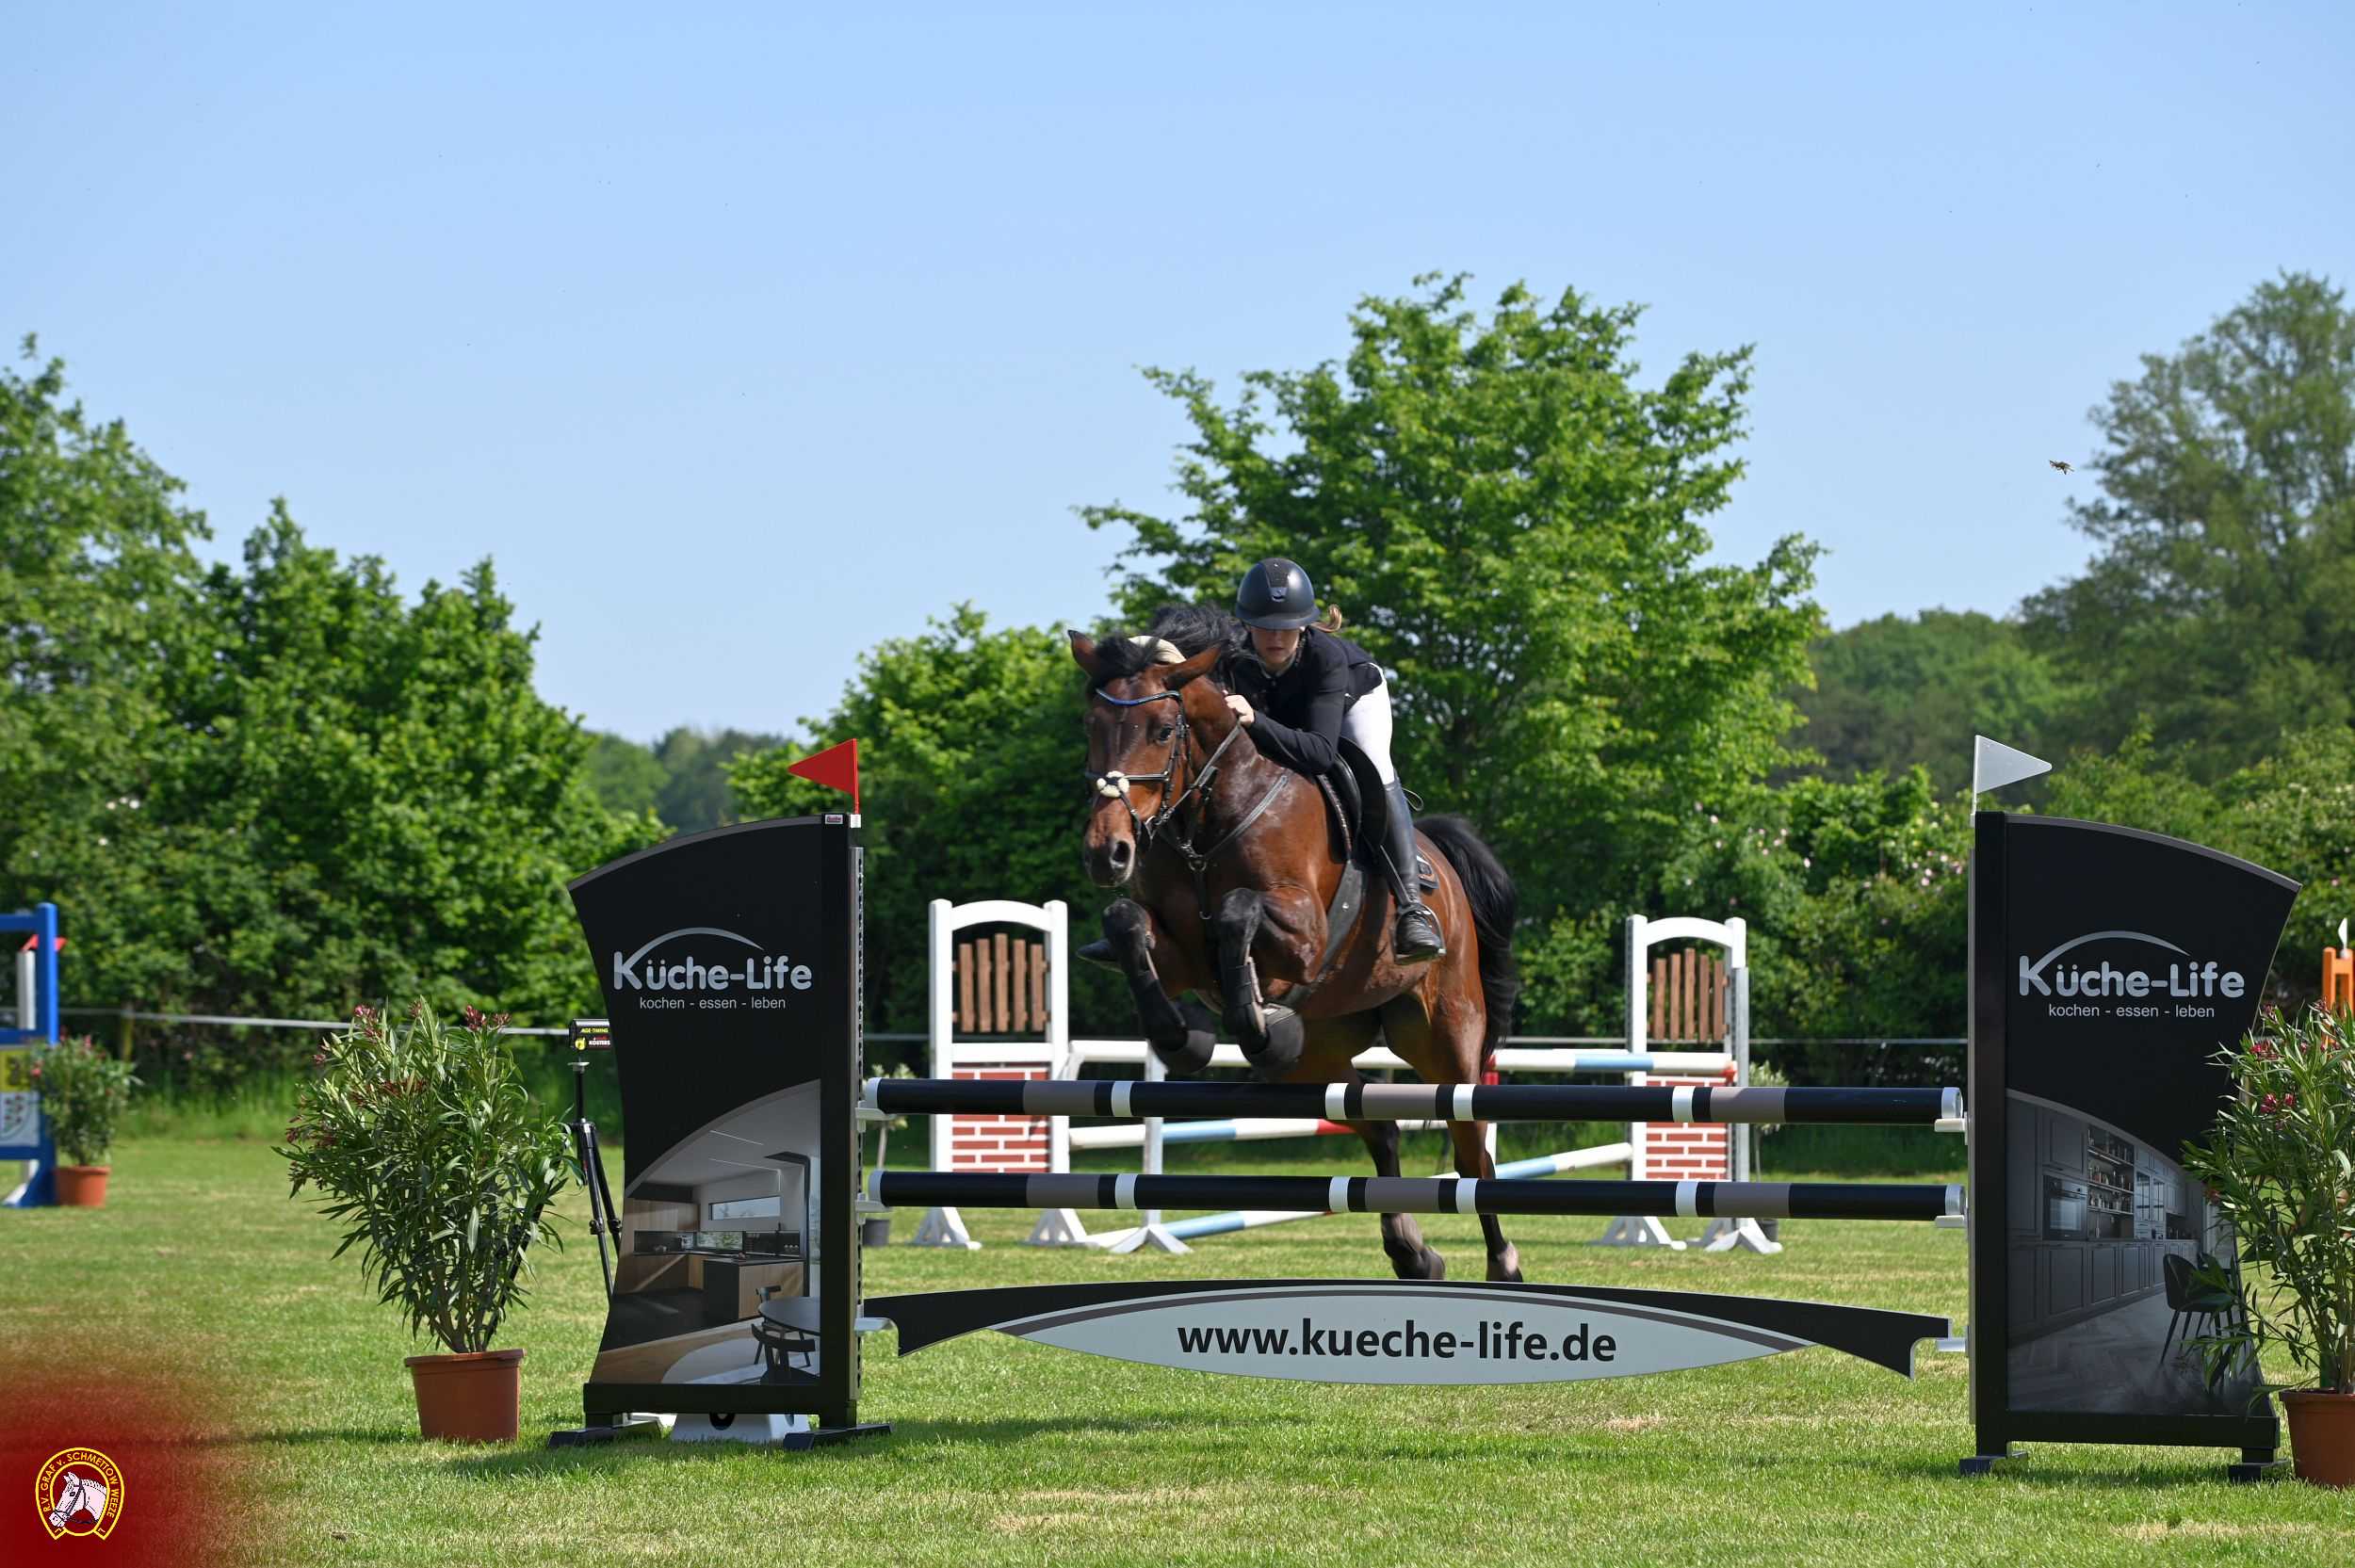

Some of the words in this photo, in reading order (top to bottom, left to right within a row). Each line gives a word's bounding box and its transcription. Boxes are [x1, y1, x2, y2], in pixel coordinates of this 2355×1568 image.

[613, 946, 812, 991] Küche-Life
[2019, 948, 2246, 998] Küche-Life
[640, 996, 685, 1010] kochen
[699, 999, 737, 1010] essen
[751, 996, 786, 1010] leben
[2049, 1003, 2100, 1017] kochen
[2116, 1007, 2159, 1018] essen
[2175, 1004, 2215, 1018] leben
[1177, 1317, 1616, 1362] www.kueche-life.de
